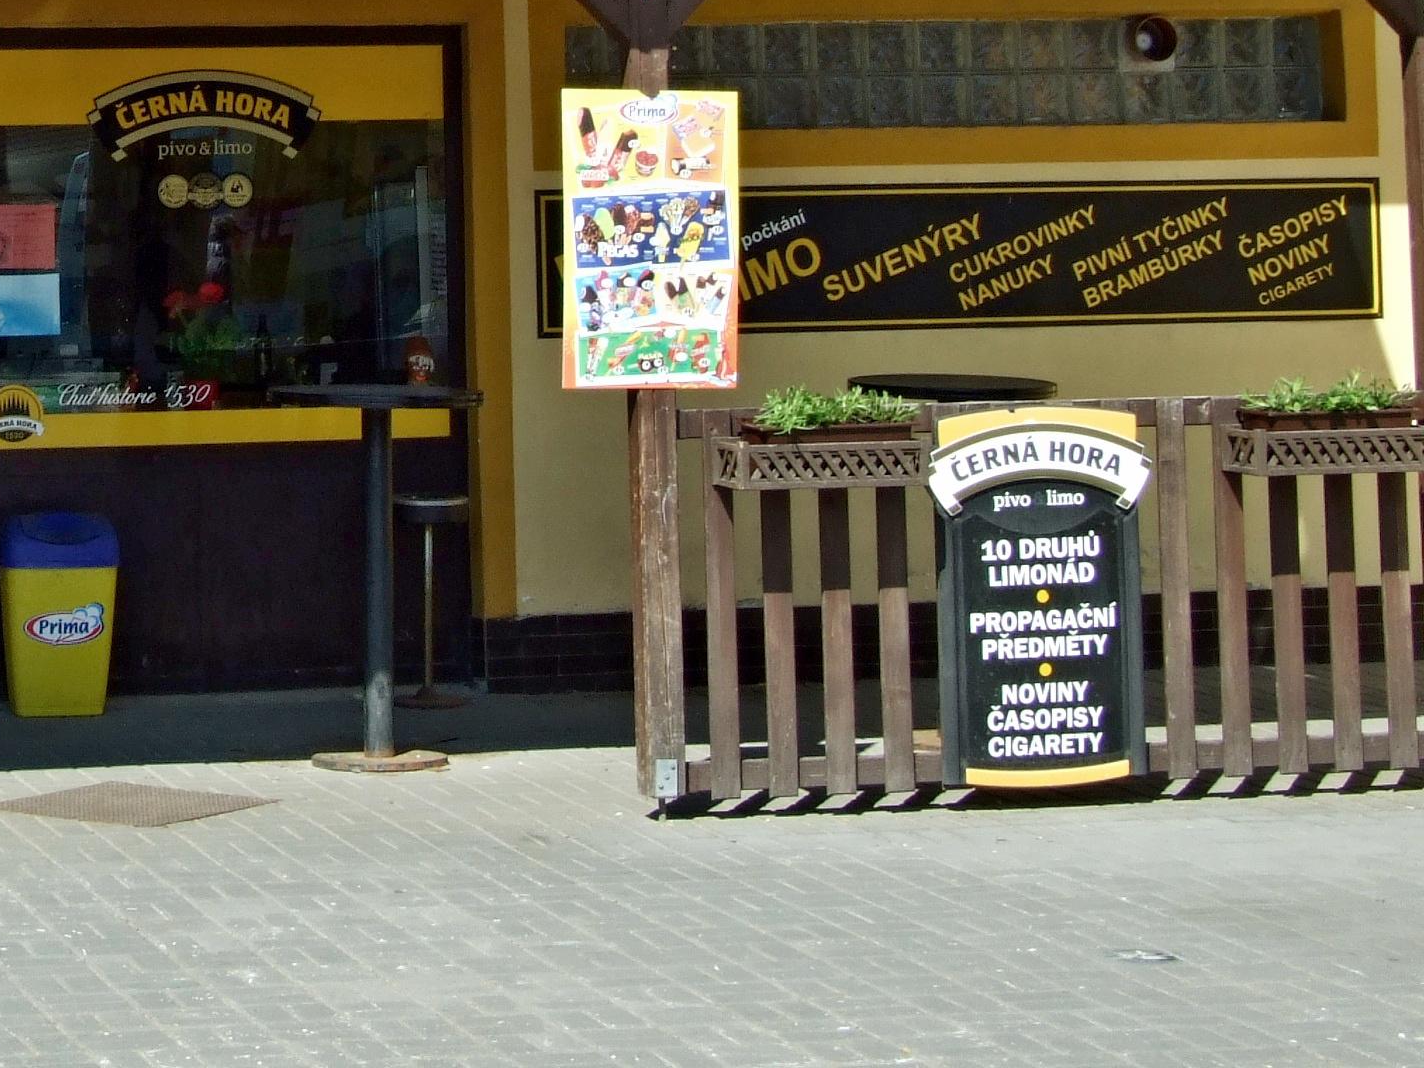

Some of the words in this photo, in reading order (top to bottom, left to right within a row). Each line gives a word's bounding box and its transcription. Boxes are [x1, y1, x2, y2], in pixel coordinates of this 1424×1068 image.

[114, 84, 210, 130] ČERNÁ
[215, 89, 290, 130] HORA
[628, 105, 666, 117] Prima
[158, 140, 196, 160] pivo
[198, 142, 211, 156] &
[213, 139, 252, 155] limo
[740, 209, 806, 251] počkání
[948, 203, 1097, 284] CUKROVINKY
[1072, 235, 1132, 282] PIVNÍ
[1132, 196, 1231, 254] TYČINKY
[1237, 194, 1349, 260] ČASOPISY
[597, 242, 639, 258] PEGAS
[822, 212, 984, 302] SUVENÝRY
[1247, 234, 1331, 287] NOVINY
[738, 237, 821, 301] IMO
[957, 254, 1054, 312] NANUKY
[1082, 229, 1224, 309] BRAMBŮRKY
[1257, 262, 1335, 307] CIGARETY
[96, 383, 157, 407] historie
[164, 384, 211, 409] 1530
[950, 435, 1040, 481] ČERNÁ
[1049, 440, 1121, 477] HORA
[993, 491, 1032, 511] pivo
[1045, 489, 1085, 505] limo
[980, 539, 1012, 561] 10
[1019, 530, 1101, 559] DRUHŮ
[988, 558, 1095, 588] LIMONÁD
[39, 619, 89, 634] Prima
[969, 601, 1117, 634] PROPAGAČNÍ
[982, 630, 1108, 661] PŘEDMĚTY
[1001, 681, 1089, 705] NOVINY
[986, 705, 1104, 732] ČASOPISY
[987, 732, 1104, 758] CIGARETY
